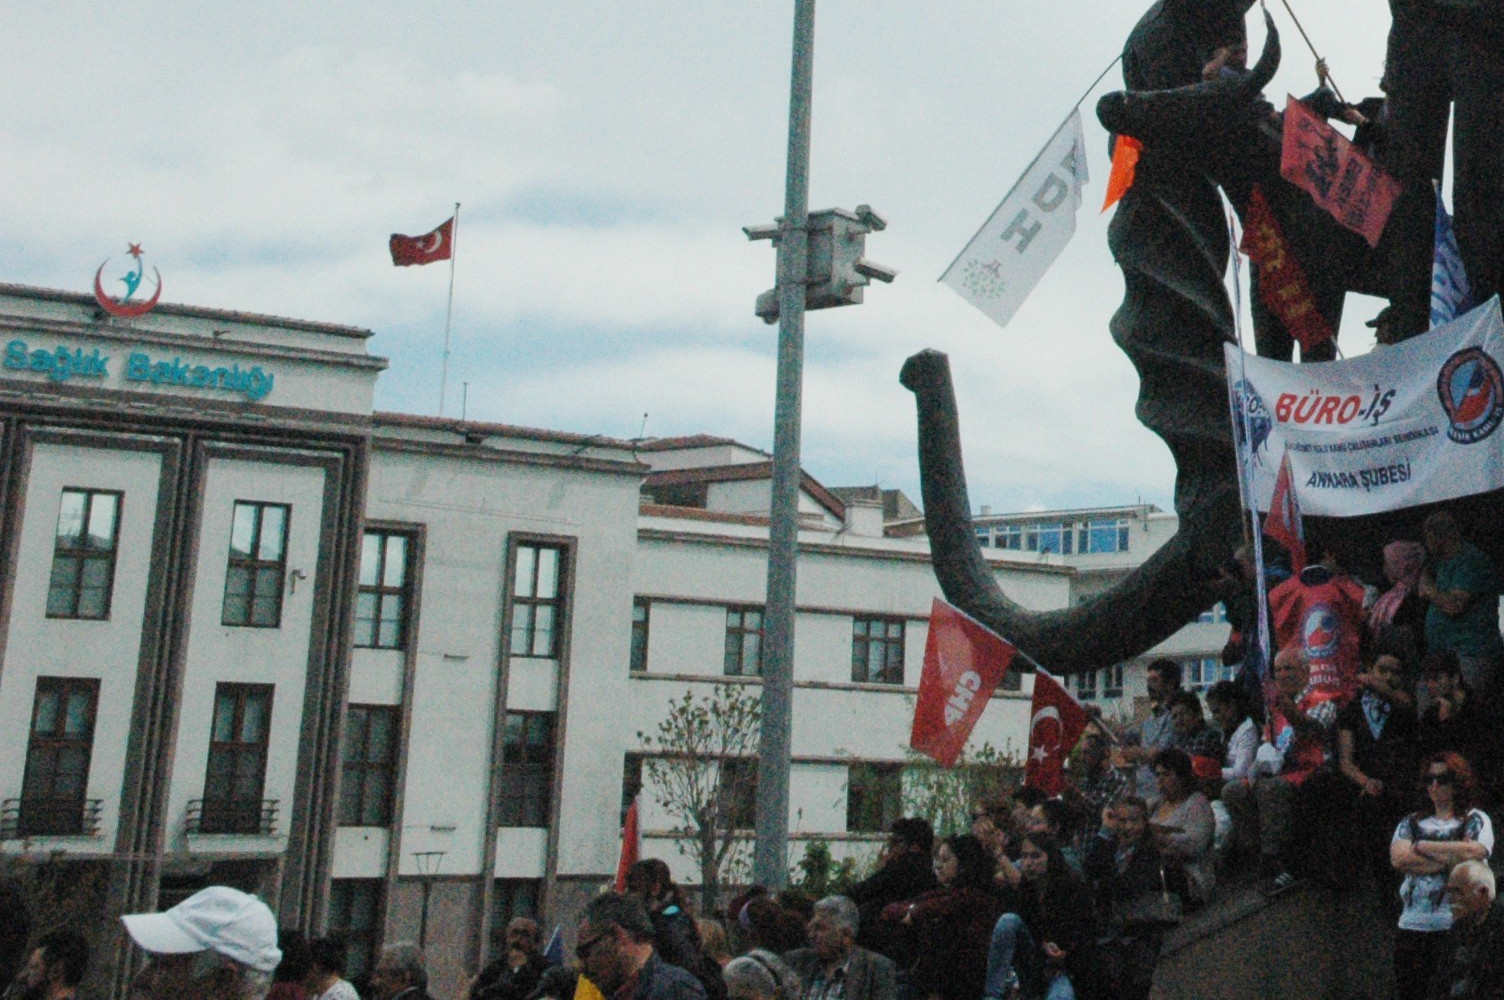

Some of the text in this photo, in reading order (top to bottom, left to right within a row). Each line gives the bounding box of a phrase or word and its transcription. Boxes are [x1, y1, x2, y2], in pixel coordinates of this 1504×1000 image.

[3, 338, 275, 402] Sağlık Bakanlığı
[1274, 383, 1397, 428] BÜRO-İŞ
[1305, 456, 1412, 492] ANKARA ŞUBESİ
